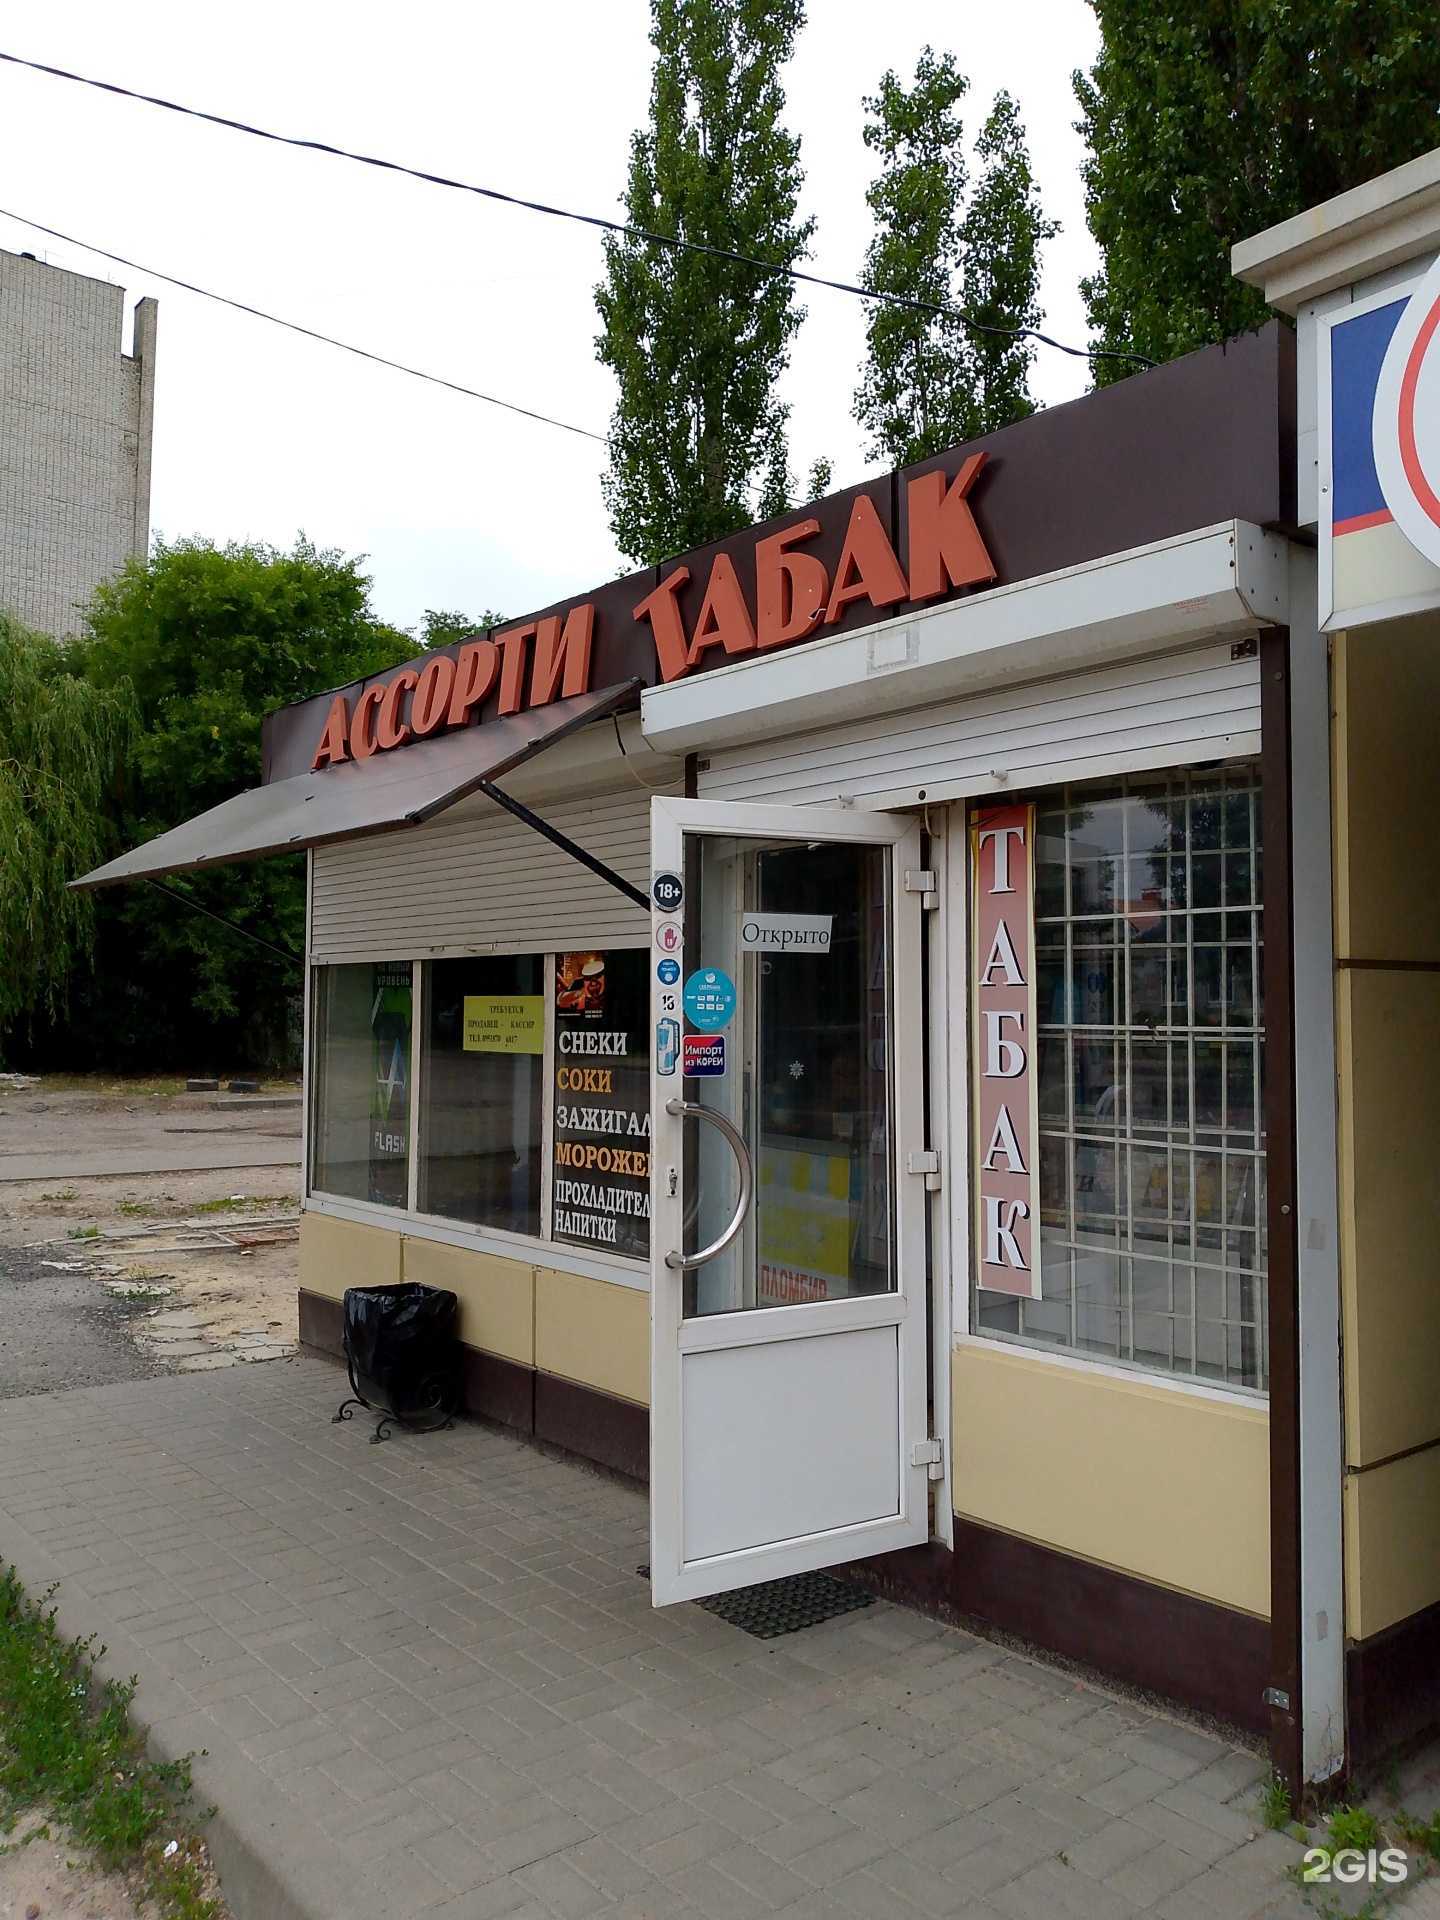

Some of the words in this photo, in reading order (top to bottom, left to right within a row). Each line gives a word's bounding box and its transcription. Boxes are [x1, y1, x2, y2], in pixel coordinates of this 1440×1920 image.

[310, 603, 595, 769] АССОРТИ
[632, 451, 998, 683] ТАБАК
[657, 883, 681, 899] 18+
[742, 922, 829, 950] Открыто
[558, 1031, 628, 1056] СНЕКИ
[685, 1045, 723, 1058] Импорт
[979, 826, 1029, 1270] ТАБАК
[557, 1068, 612, 1093] СОКИ
[556, 1106, 650, 1137] ЗАЖИГАЛ
[556, 1180, 650, 1218] ПРОХЛАДИТЕЛ
[554, 1210, 617, 1243] НАПИТКИ
